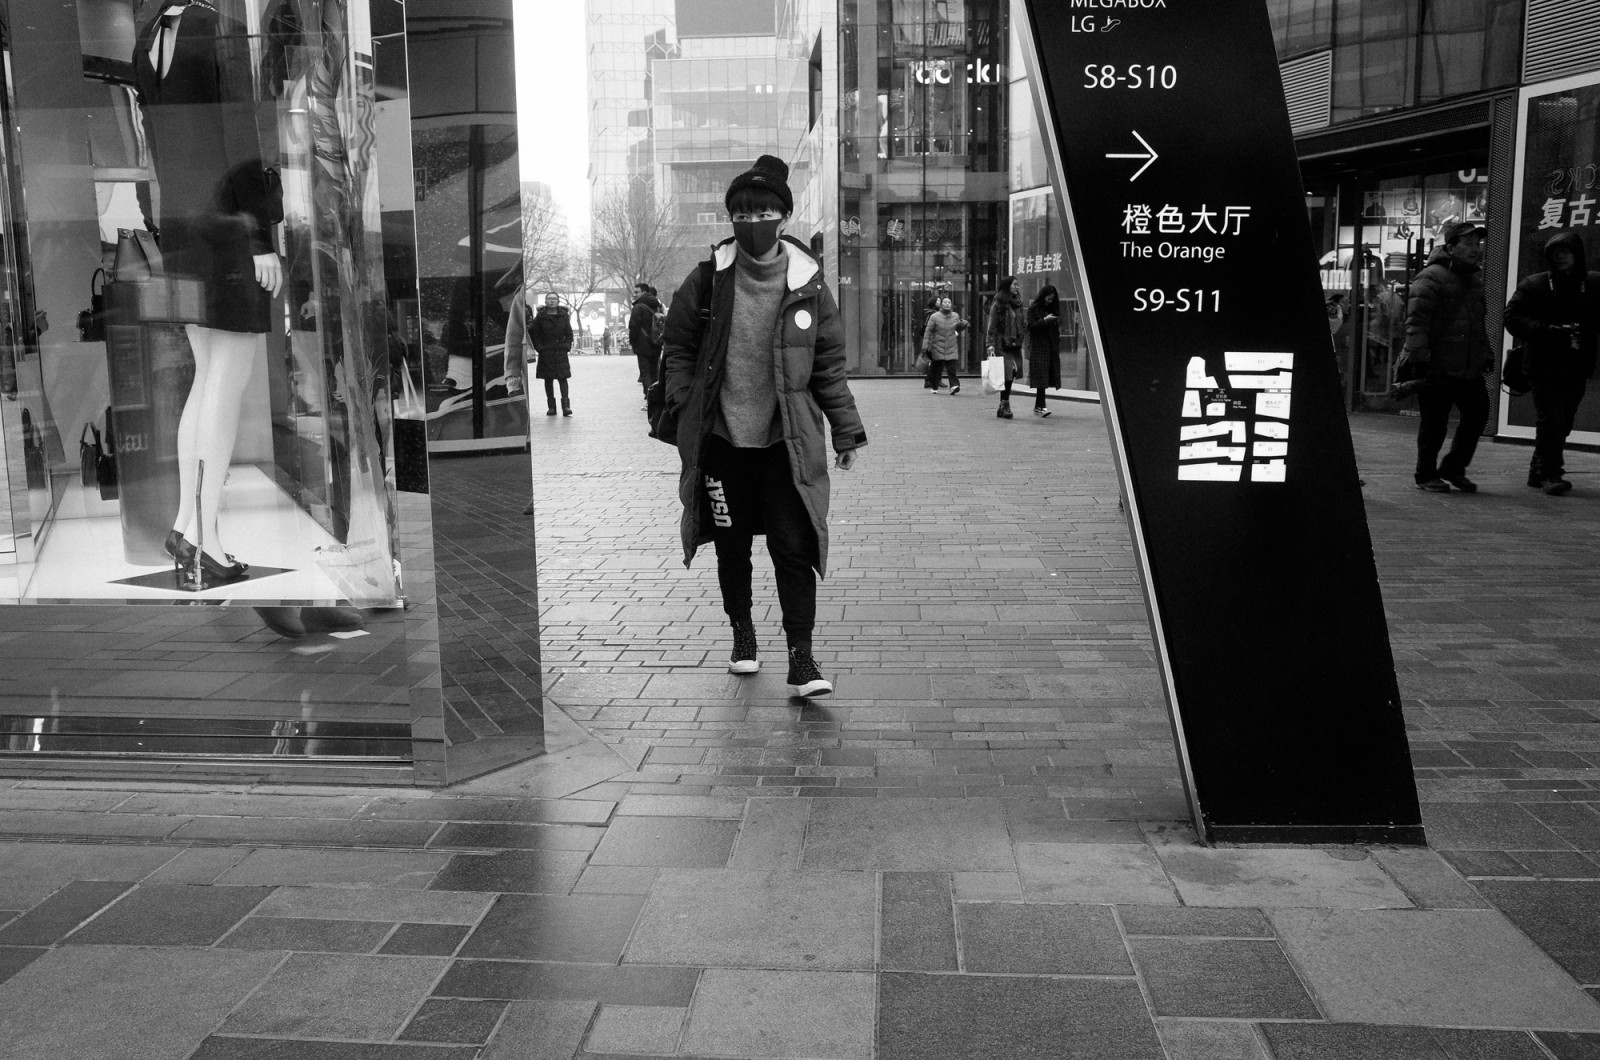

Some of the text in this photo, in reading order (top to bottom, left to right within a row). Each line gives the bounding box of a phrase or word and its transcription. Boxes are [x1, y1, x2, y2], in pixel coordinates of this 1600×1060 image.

[1071, 15, 1095, 33] LG
[1083, 63, 1177, 90] S8-S10
[1120, 203, 1252, 236] 橙色大厅
[1537, 193, 1600, 230] 复古
[1016, 252, 1062, 274] 复古星主张
[1119, 241, 1226, 264] The Orange
[1133, 287, 1220, 313] S9-S11
[704, 474, 733, 528] USAF
